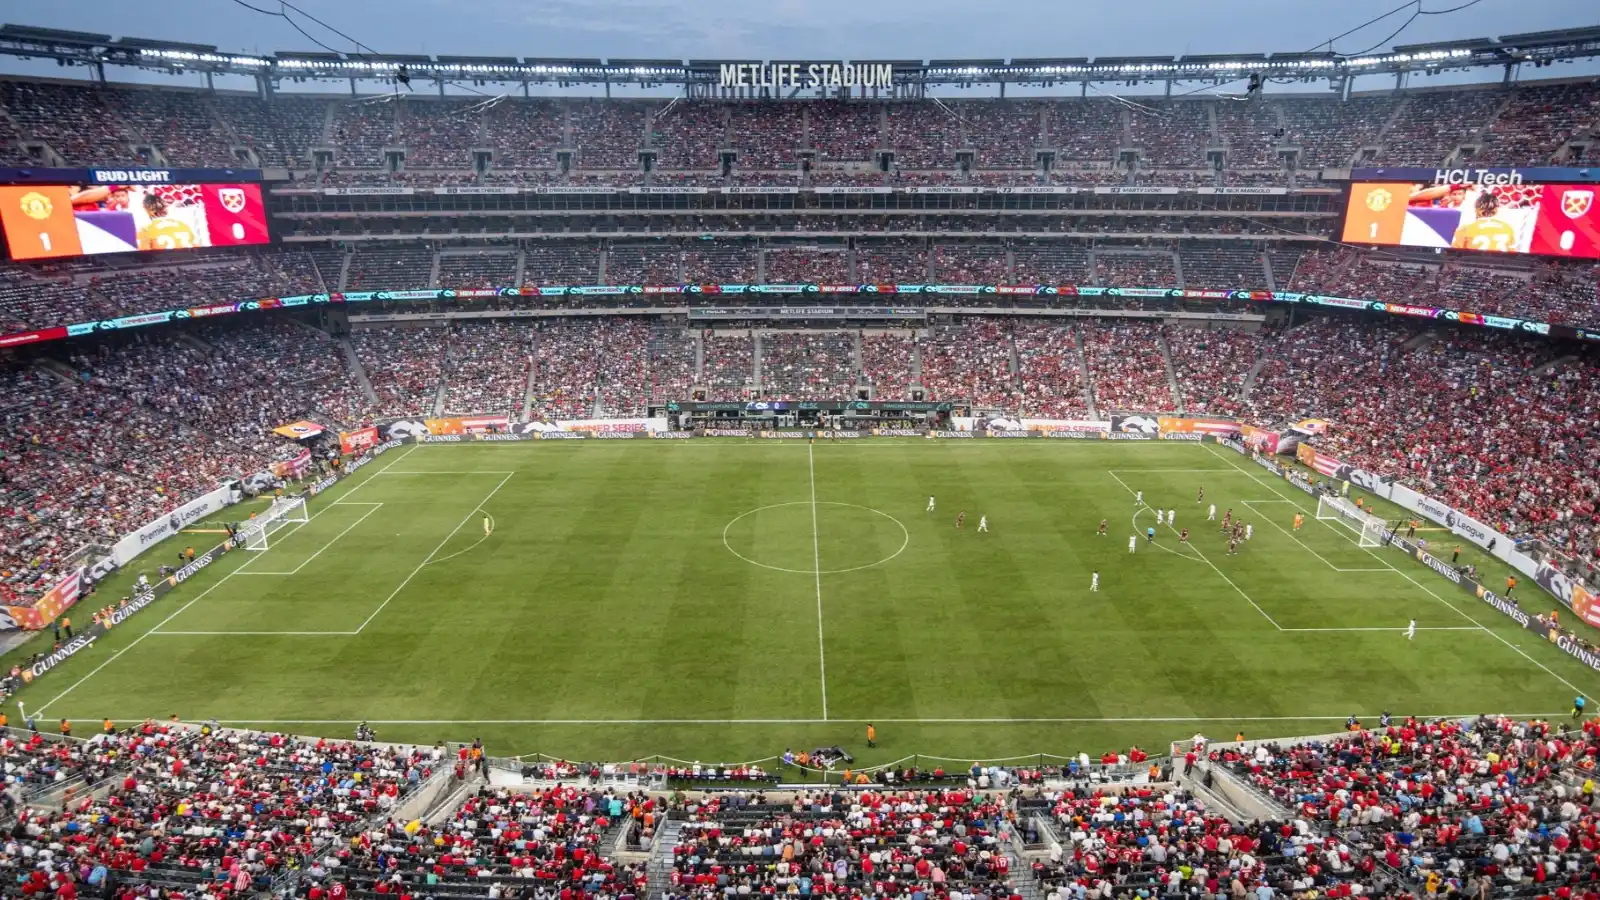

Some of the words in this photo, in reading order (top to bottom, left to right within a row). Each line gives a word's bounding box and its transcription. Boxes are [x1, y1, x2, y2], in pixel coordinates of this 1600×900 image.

[719, 63, 801, 87] METLIFE
[808, 63, 892, 87] STADIUM
[96, 170, 128, 182] BUD
[128, 170, 170, 182] LIGHT
[1434, 168, 1523, 185] HCLTech
[231, 222, 245, 240] 0
[1369, 223, 1378, 239] 1
[1560, 229, 1576, 250] 0
[40, 232, 51, 251] 1
[194, 308, 210, 316] NEW
[211, 306, 233, 314] JERSEY
[1391, 305, 1407, 313] NEW
[1407, 307, 1433, 316] JERSEY
[539, 431, 577, 439] GUINNESS
[612, 423, 647, 432] SERIES
[423, 434, 461, 442] GUINNESS
[482, 433, 520, 441] GUINNESS
[139, 523, 168, 544] Premier
[180, 502, 208, 520] League
[1416, 499, 1445, 518] Premier
[1456, 518, 1485, 540] League
[176, 553, 213, 582] GUINNESS
[1422, 553, 1460, 584] GUINNESS
[111, 591, 155, 625] GUINNESS
[1483, 590, 1530, 628] GUINNESS
[32, 635, 87, 677] GUINNESS
